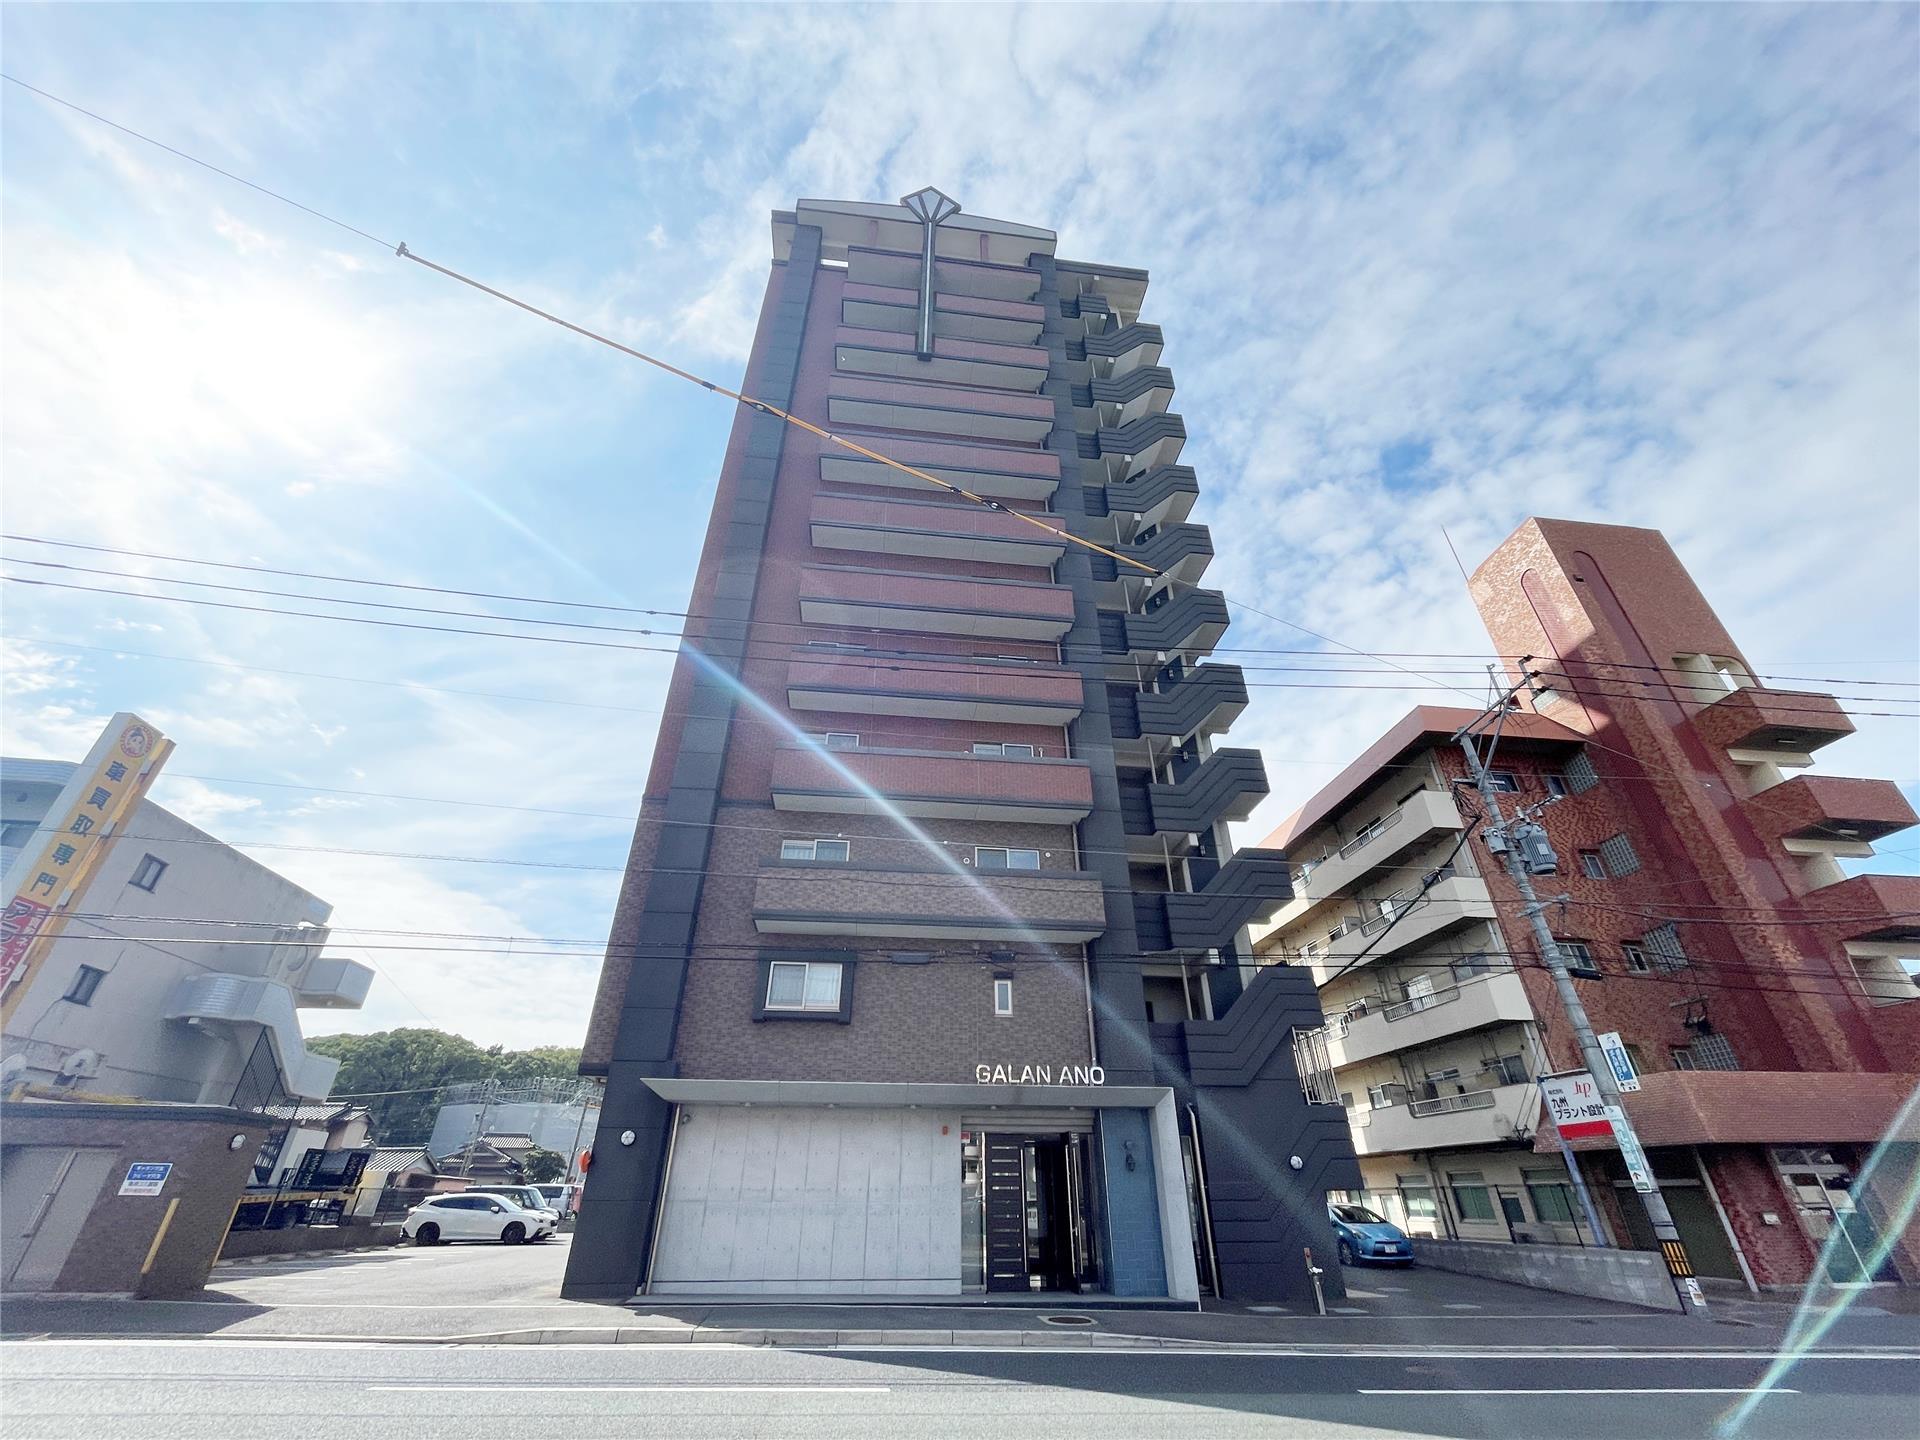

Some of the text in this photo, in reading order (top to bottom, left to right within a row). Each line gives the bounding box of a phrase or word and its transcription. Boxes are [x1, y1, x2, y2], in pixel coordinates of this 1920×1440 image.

[30, 760, 129, 897] 車買取専門
[975, 1063, 1105, 1085] GALAN ANO
[1551, 1097, 1569, 1111] 九州
[1555, 1104, 1606, 1121] プラント設計
